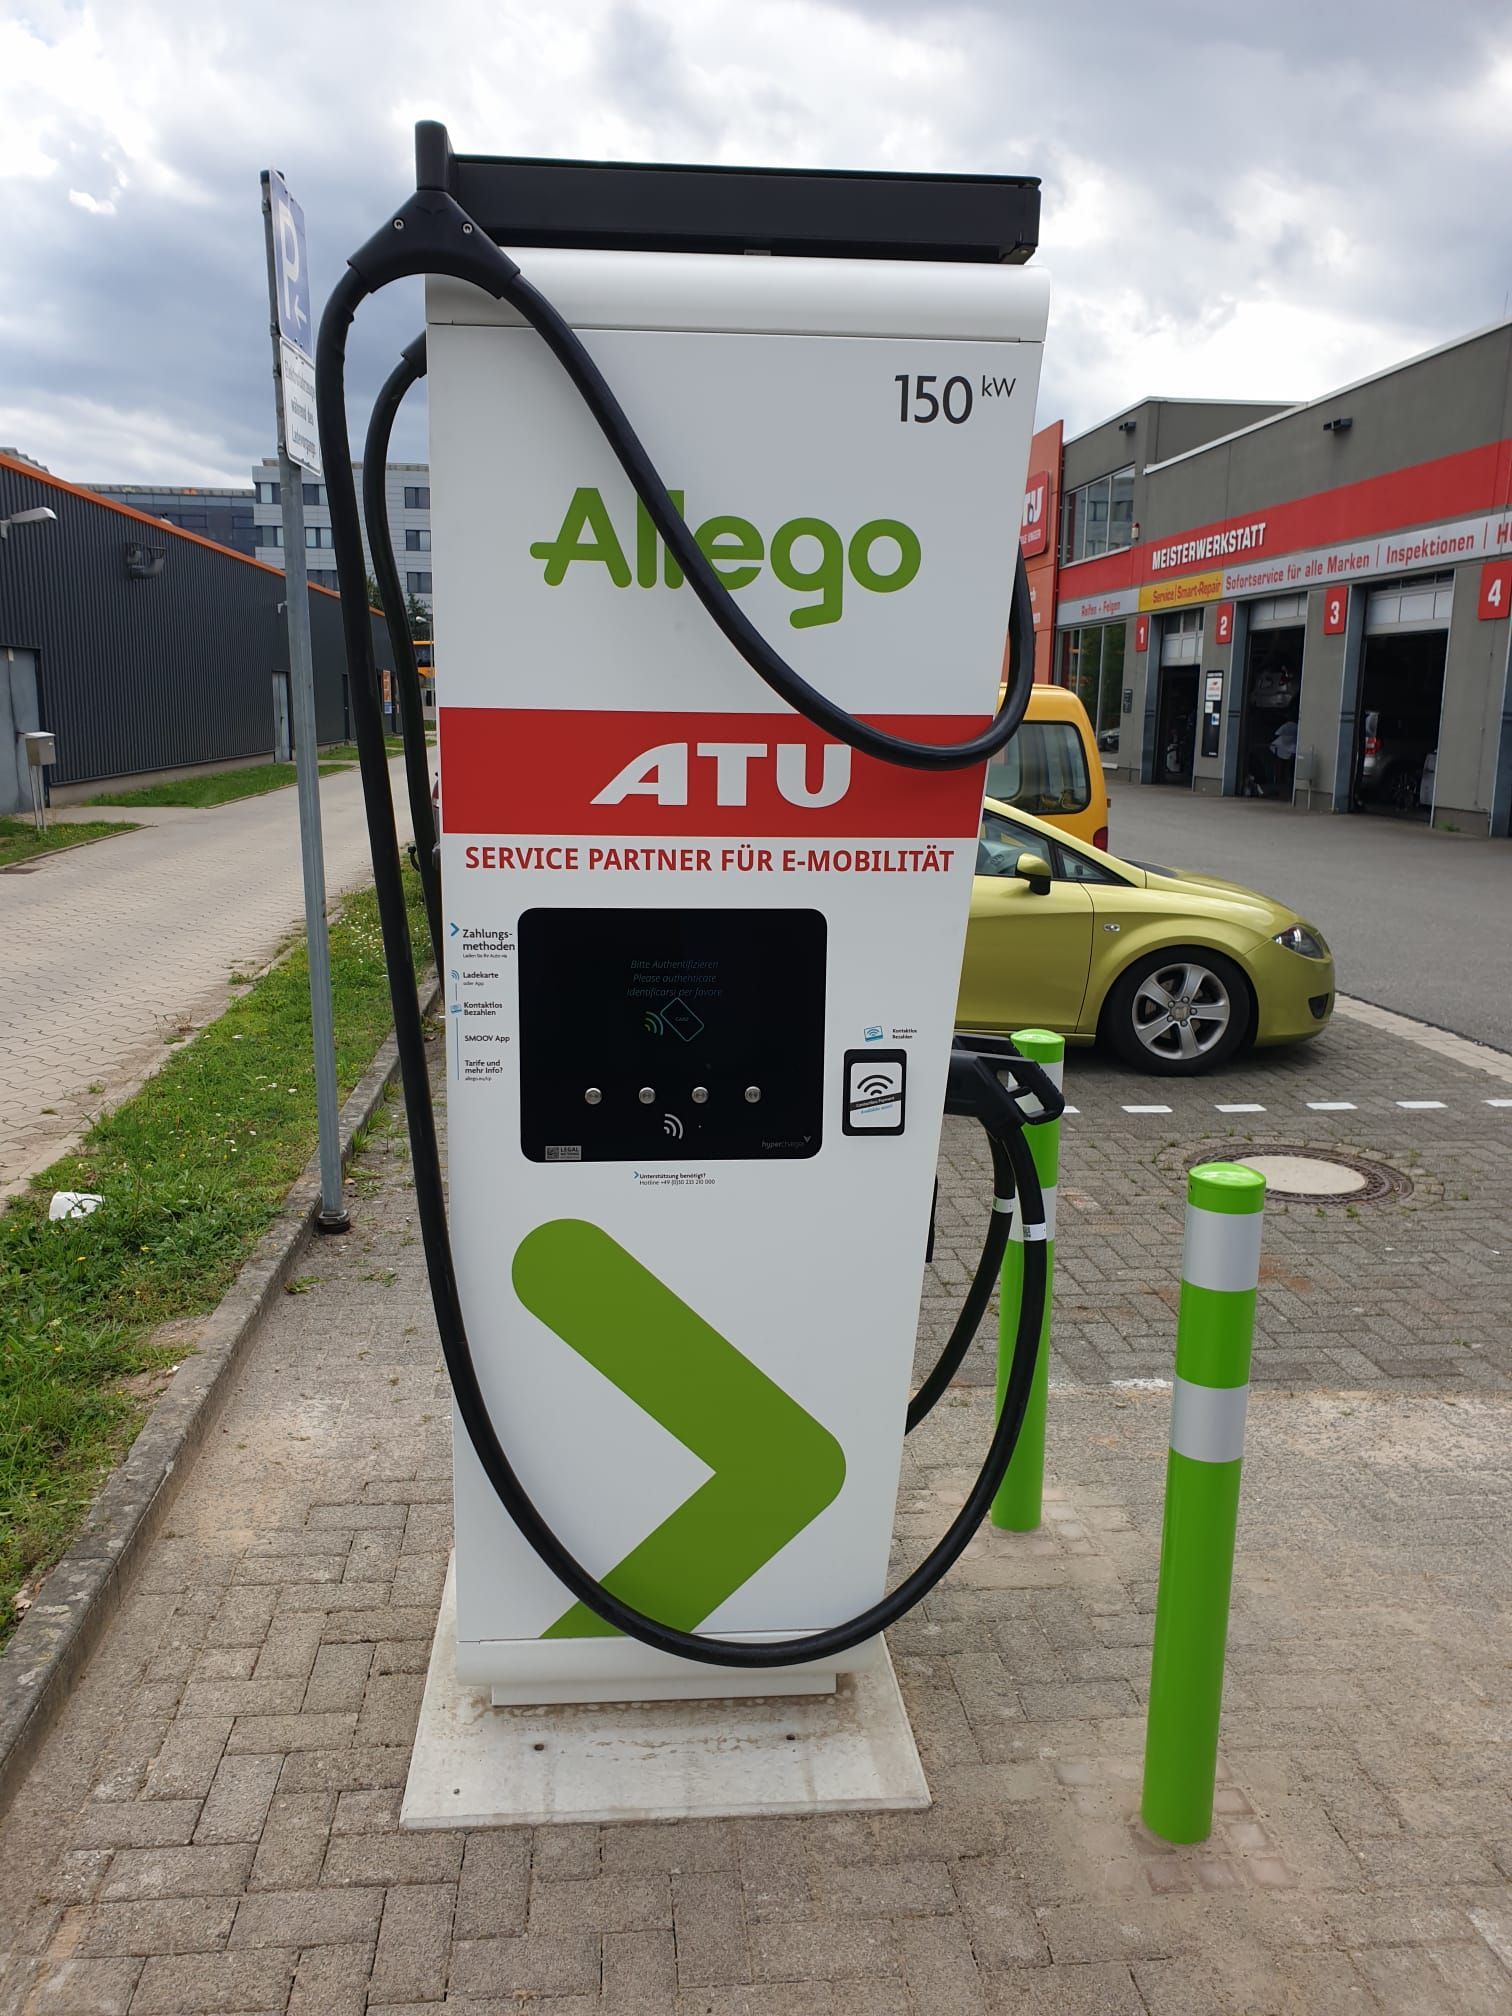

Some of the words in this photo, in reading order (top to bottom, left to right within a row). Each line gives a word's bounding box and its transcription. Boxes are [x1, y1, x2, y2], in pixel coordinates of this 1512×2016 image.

[278, 200, 300, 321] P
[894, 374, 973, 425] 150
[981, 374, 1017, 398] kW
[1023, 486, 1044, 528] TU
[1151, 522, 1266, 571] MEISTERWERKSTATT
[1225, 568, 1284, 591] Sofortservice
[1287, 564, 1301, 579] für
[1305, 559, 1323, 577] alle
[1327, 552, 1370, 574] Marken
[1386, 534, 1475, 566] Inspektionen
[1152, 589, 1174, 604] Service
[1177, 578, 1221, 600] Smart-Repair
[1487, 578, 1502, 607] 4
[1080, 605, 1097, 617] Reifen
[1103, 600, 1121, 615] Felgen
[1330, 600, 1340, 625] 3
[1219, 615, 1228, 635] 2
[1139, 627, 1145, 644] 1
[590, 742, 852, 809] ATU
[465, 846, 579, 871] SERVICE
[588, 847, 712, 872] PARTNER
[721, 844, 774, 872] FÜR
[782, 844, 955, 873] E-MOBILITÄT
[462, 928, 513, 941] Zahlungs-
[462, 941, 516, 951] methoden
[630, 959, 650, 969] Bitte
[651, 959, 719, 969] Authentifizieren
[462, 971, 499, 979] Ladekarte
[633, 973, 660, 982] Please
[662, 973, 717, 982] authenticate
[495, 1035, 510, 1043] App
[464, 1059, 485, 1067] Tarife
[486, 1059, 501, 1067] und
[464, 1066, 483, 1074] mehr
[485, 1066, 503, 1074] Info?
